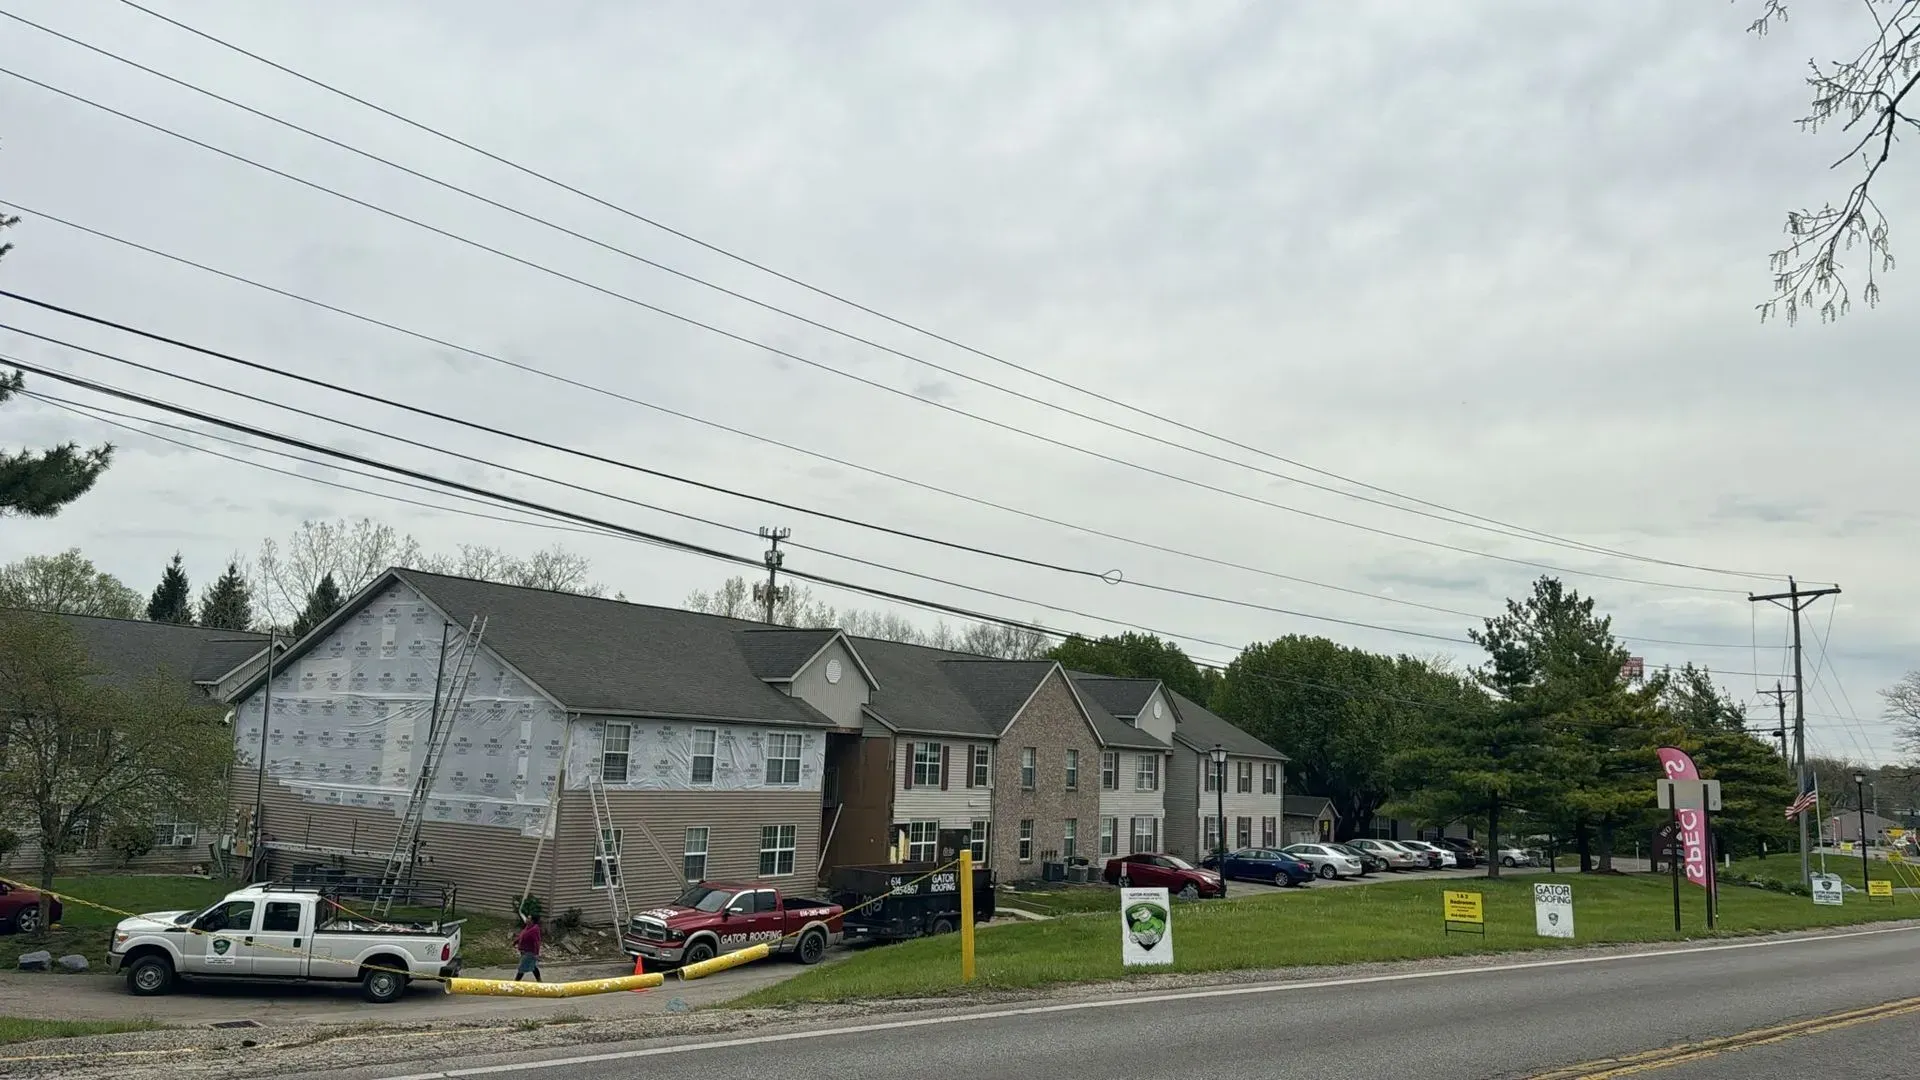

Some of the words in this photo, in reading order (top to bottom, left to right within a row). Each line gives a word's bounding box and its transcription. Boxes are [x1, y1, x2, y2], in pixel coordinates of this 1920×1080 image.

[890, 877, 901, 886] 614
[932, 873, 954, 883] GATOR
[931, 882, 955, 892] ROOFING
[1535, 884, 1570, 896] GATOR
[1536, 894, 1571, 904] ROOFING
[720, 932, 746, 945] GATOR
[749, 929, 783, 942] ROOFING
